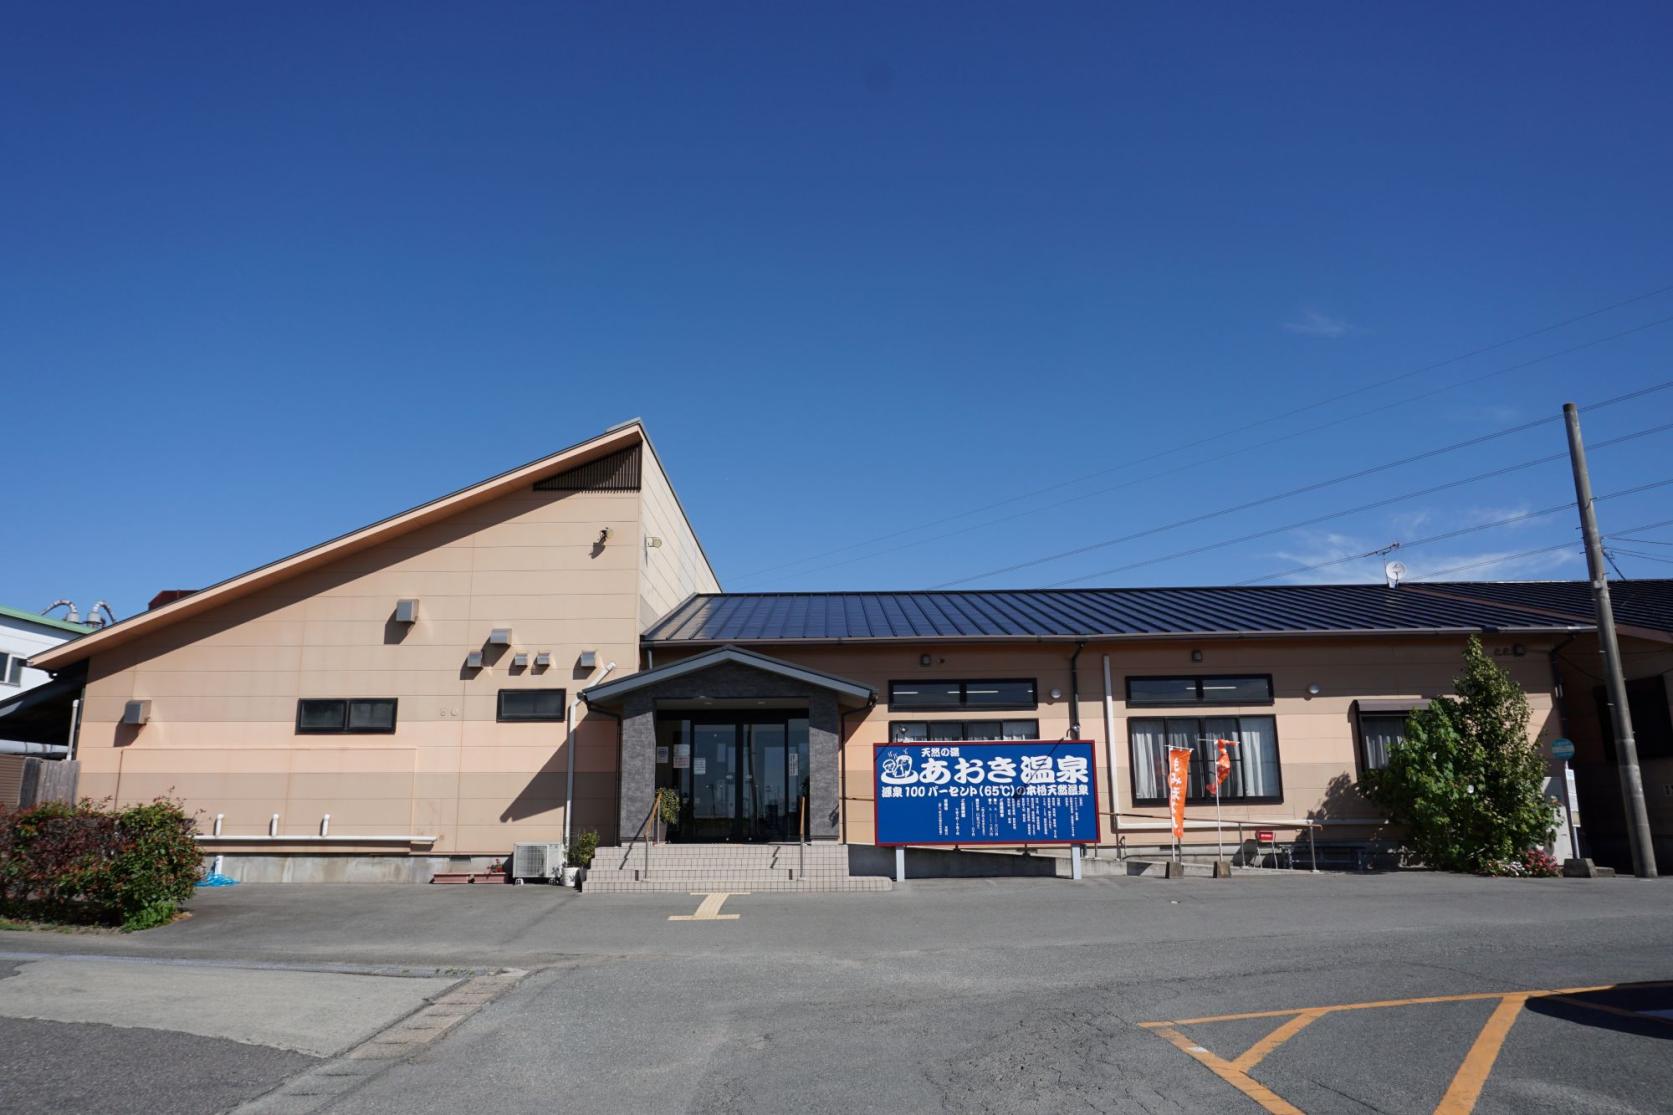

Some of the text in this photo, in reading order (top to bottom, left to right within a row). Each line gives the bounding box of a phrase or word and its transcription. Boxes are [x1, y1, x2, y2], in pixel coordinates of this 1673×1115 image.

[919, 755, 1089, 784] あおき温泉
